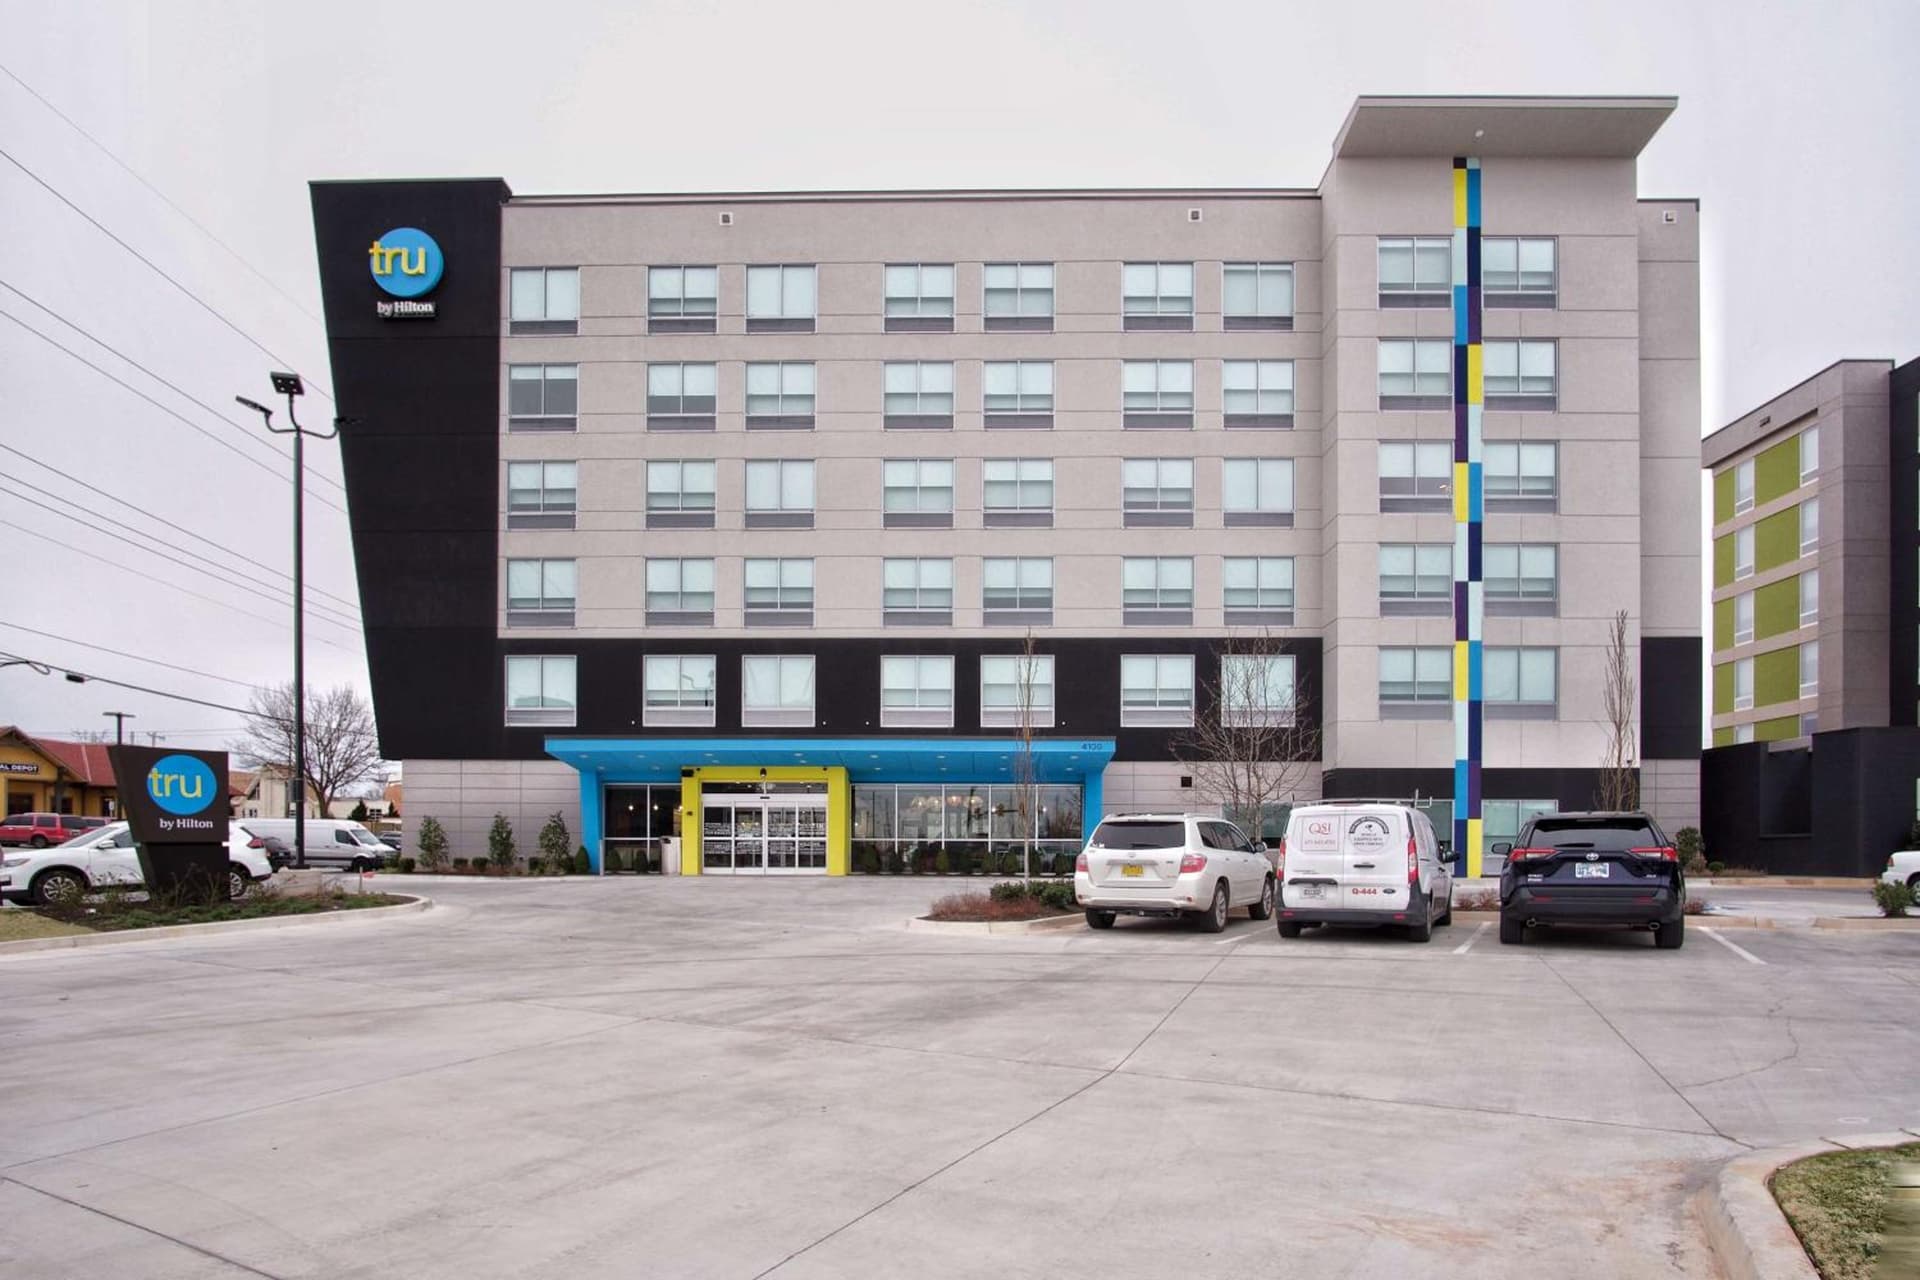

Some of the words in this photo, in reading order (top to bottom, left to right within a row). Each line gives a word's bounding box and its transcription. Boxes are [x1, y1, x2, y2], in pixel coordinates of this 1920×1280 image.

[369, 241, 426, 275] tru
[377, 301, 393, 316] by
[394, 301, 434, 314] Hilton
[148, 767, 202, 798] tru
[160, 818, 174, 831] by
[176, 818, 214, 829] Hilton
[1309, 822, 1331, 836] QSI
